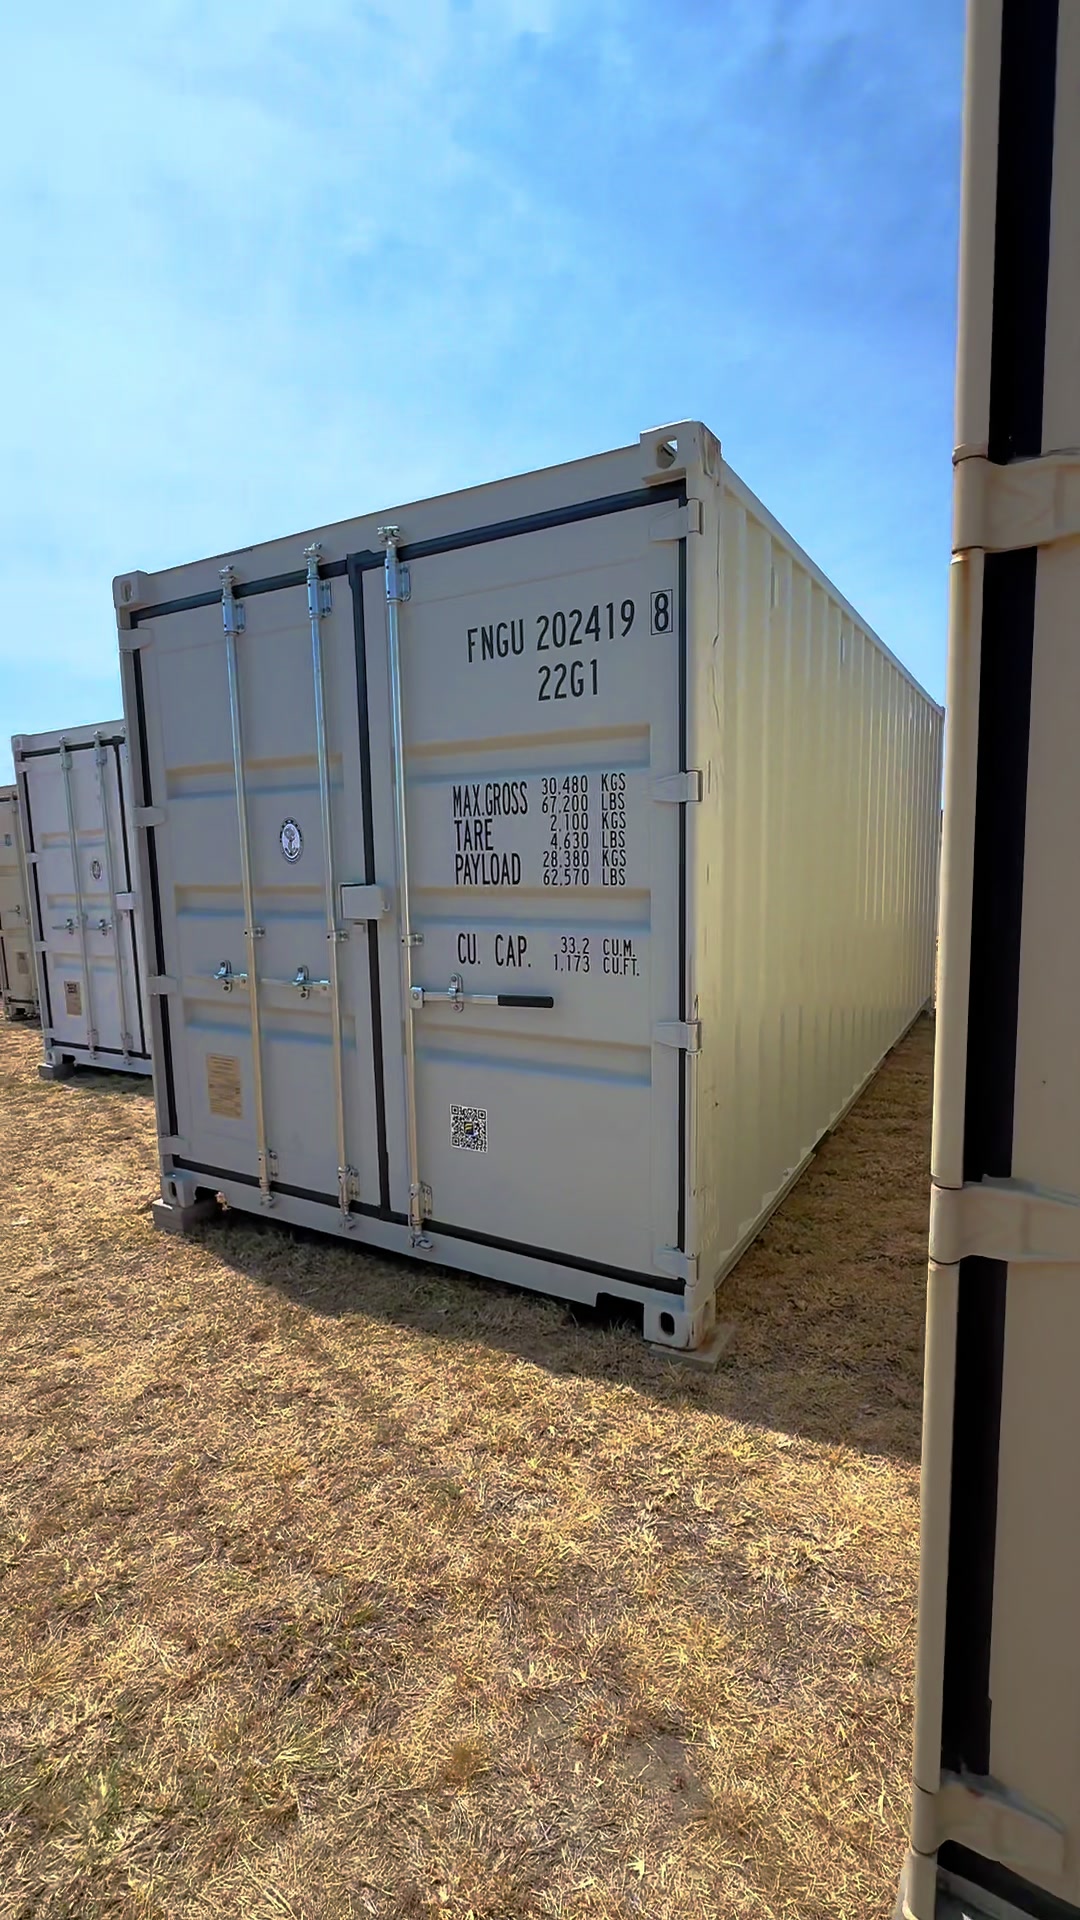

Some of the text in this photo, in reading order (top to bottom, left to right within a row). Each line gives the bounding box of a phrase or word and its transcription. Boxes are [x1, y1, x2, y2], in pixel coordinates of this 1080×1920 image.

[467, 592, 669, 663] FNGU 202419 8
[538, 658, 598, 701] 22G1
[453, 781, 528, 817] MAX.GROSS
[601, 772, 626, 792] KGS
[601, 792, 625, 811] LBS
[454, 818, 494, 851] TARE
[602, 811, 626, 830] KGS
[602, 830, 626, 849] LBS
[455, 852, 521, 885] PAYLOAD
[602, 849, 627, 867] KGS
[602, 868, 627, 886] LBS
[457, 932, 636, 968] CU. CAP. 33.2 CU.M.
[603, 956, 640, 977] CU.FT.
